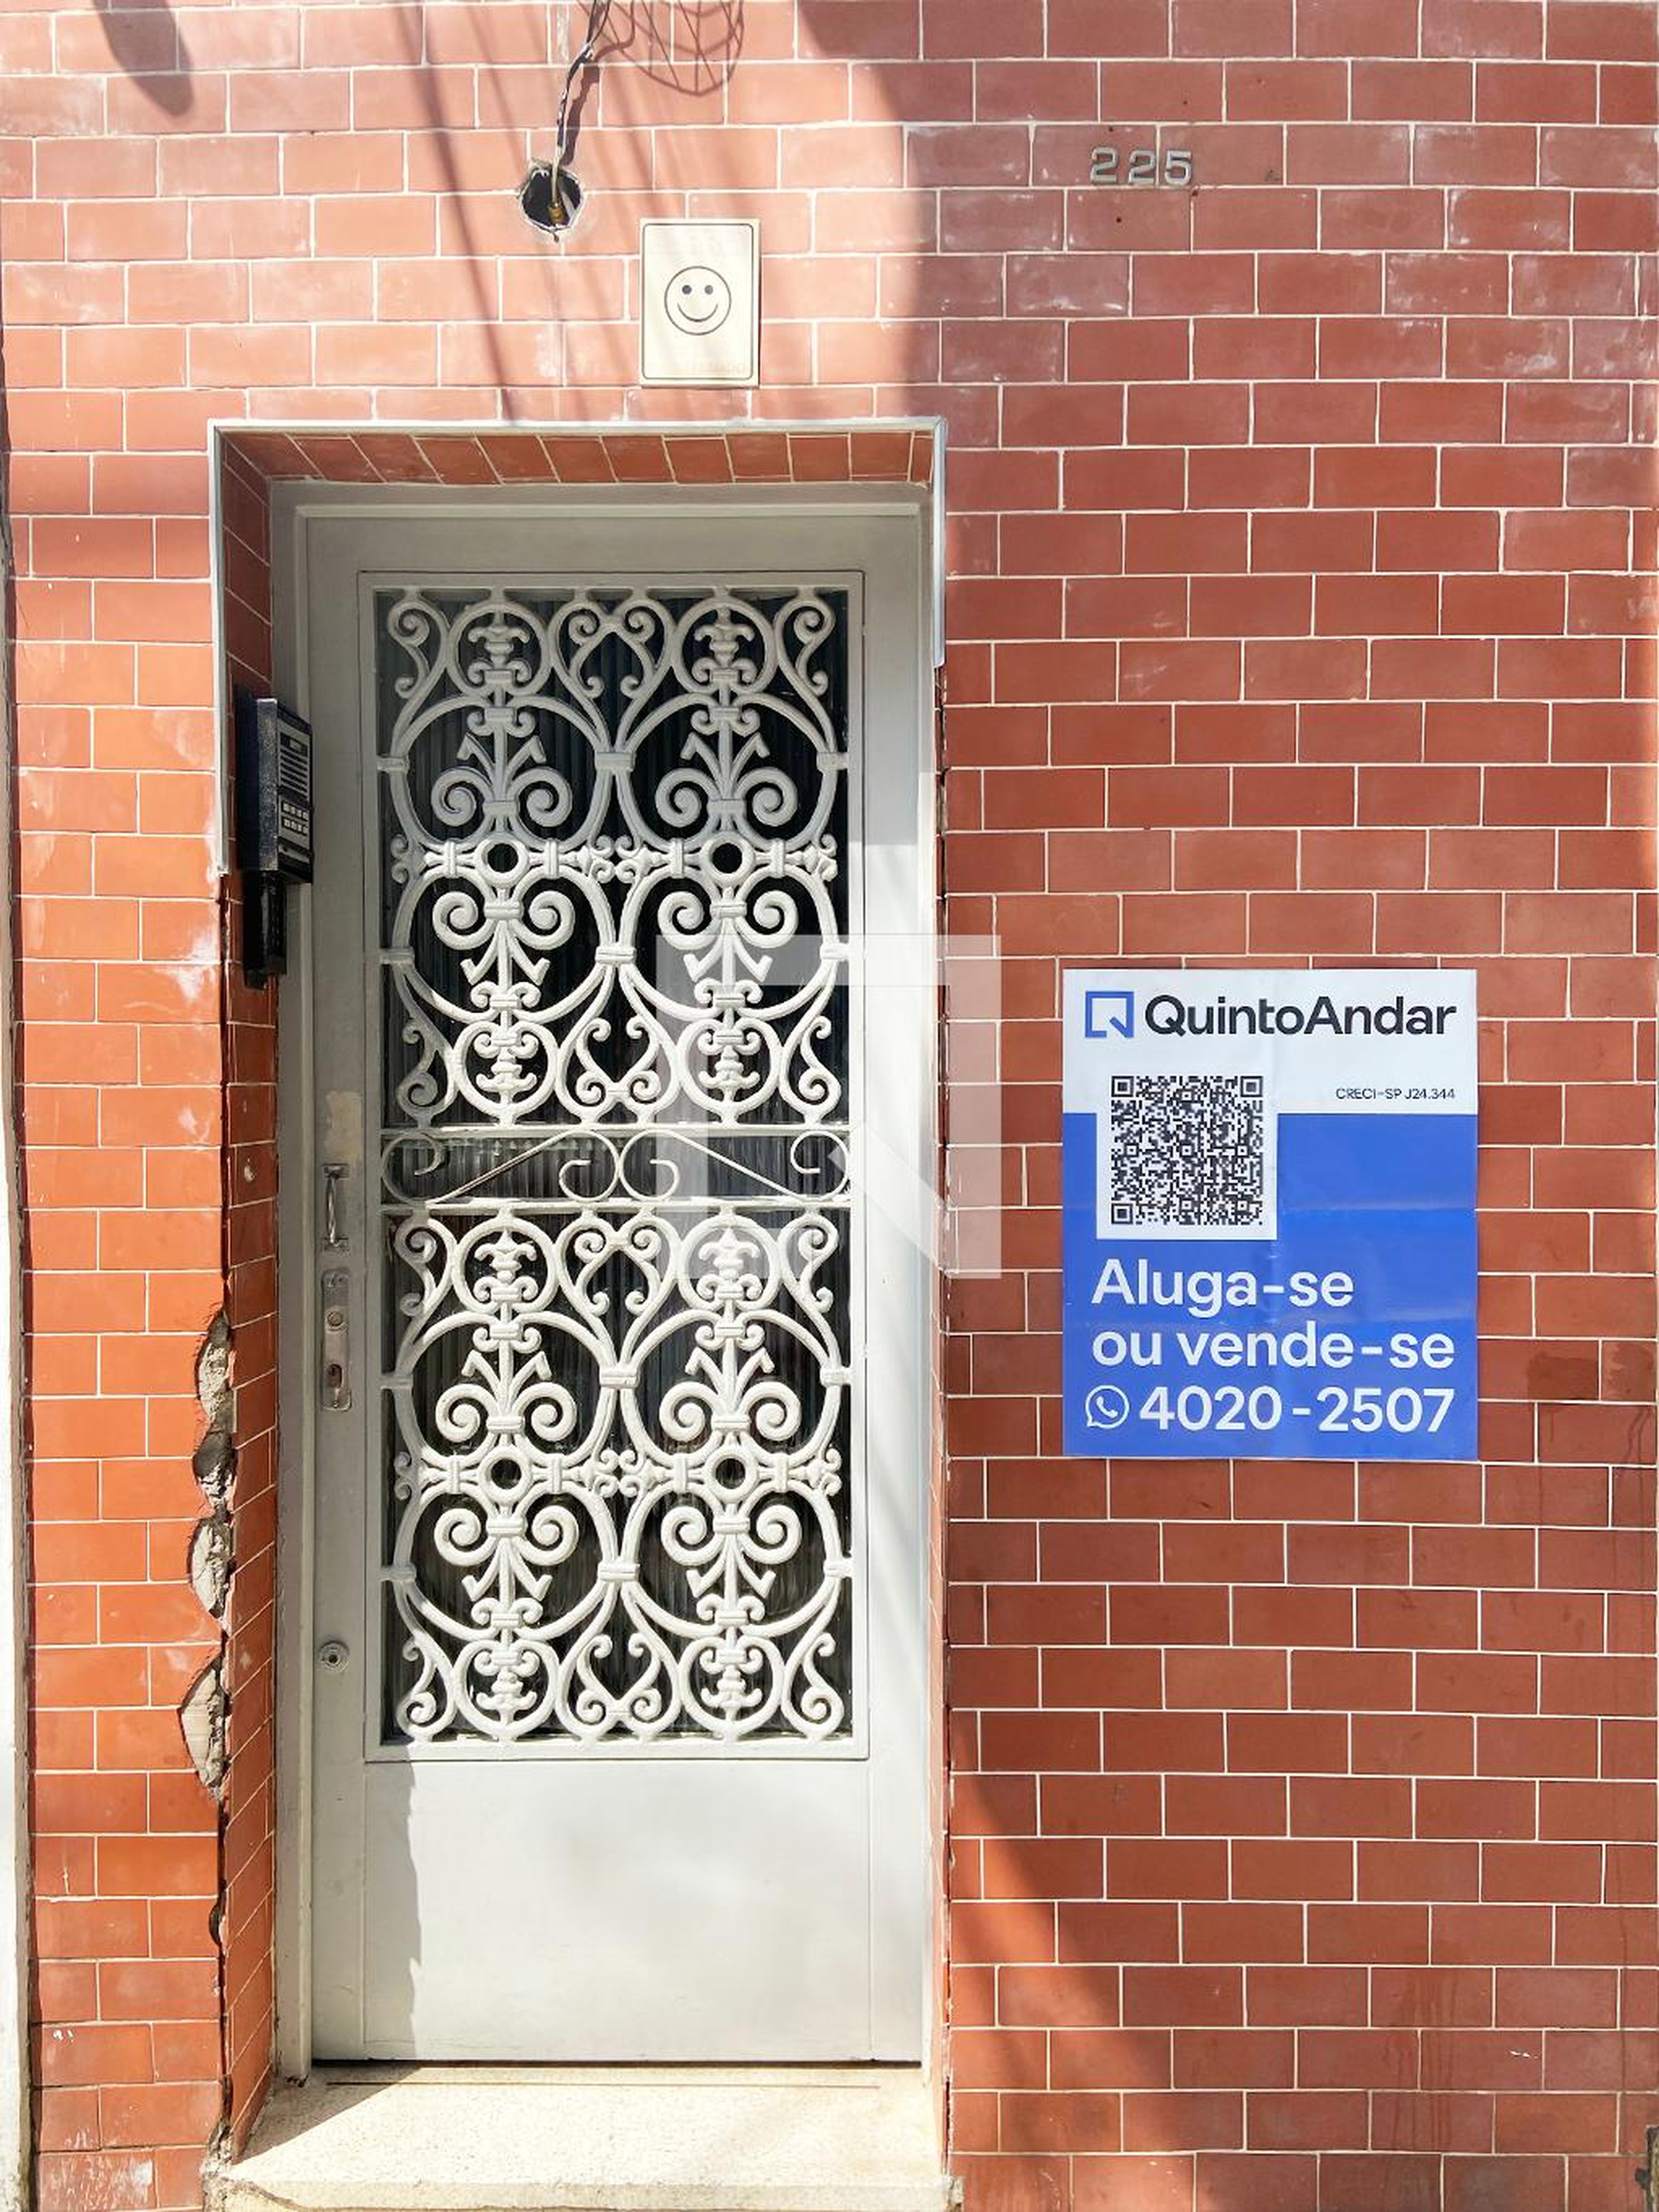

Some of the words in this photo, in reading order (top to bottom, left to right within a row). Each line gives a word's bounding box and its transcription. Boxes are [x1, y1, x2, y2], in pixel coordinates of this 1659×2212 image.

[1090, 146, 1191, 185] 225
[1145, 995, 1456, 1037] QuintoAndar
[1335, 1088, 1402, 1100] CRECI-SP
[1404, 1088, 1455, 1100] J24.344
[1092, 1259, 1353, 1318] Aluga-se
[1093, 1331, 1161, 1366] ou
[1176, 1320, 1454, 1369] vende-se
[1140, 1385, 1454, 1432] 4020-2507
